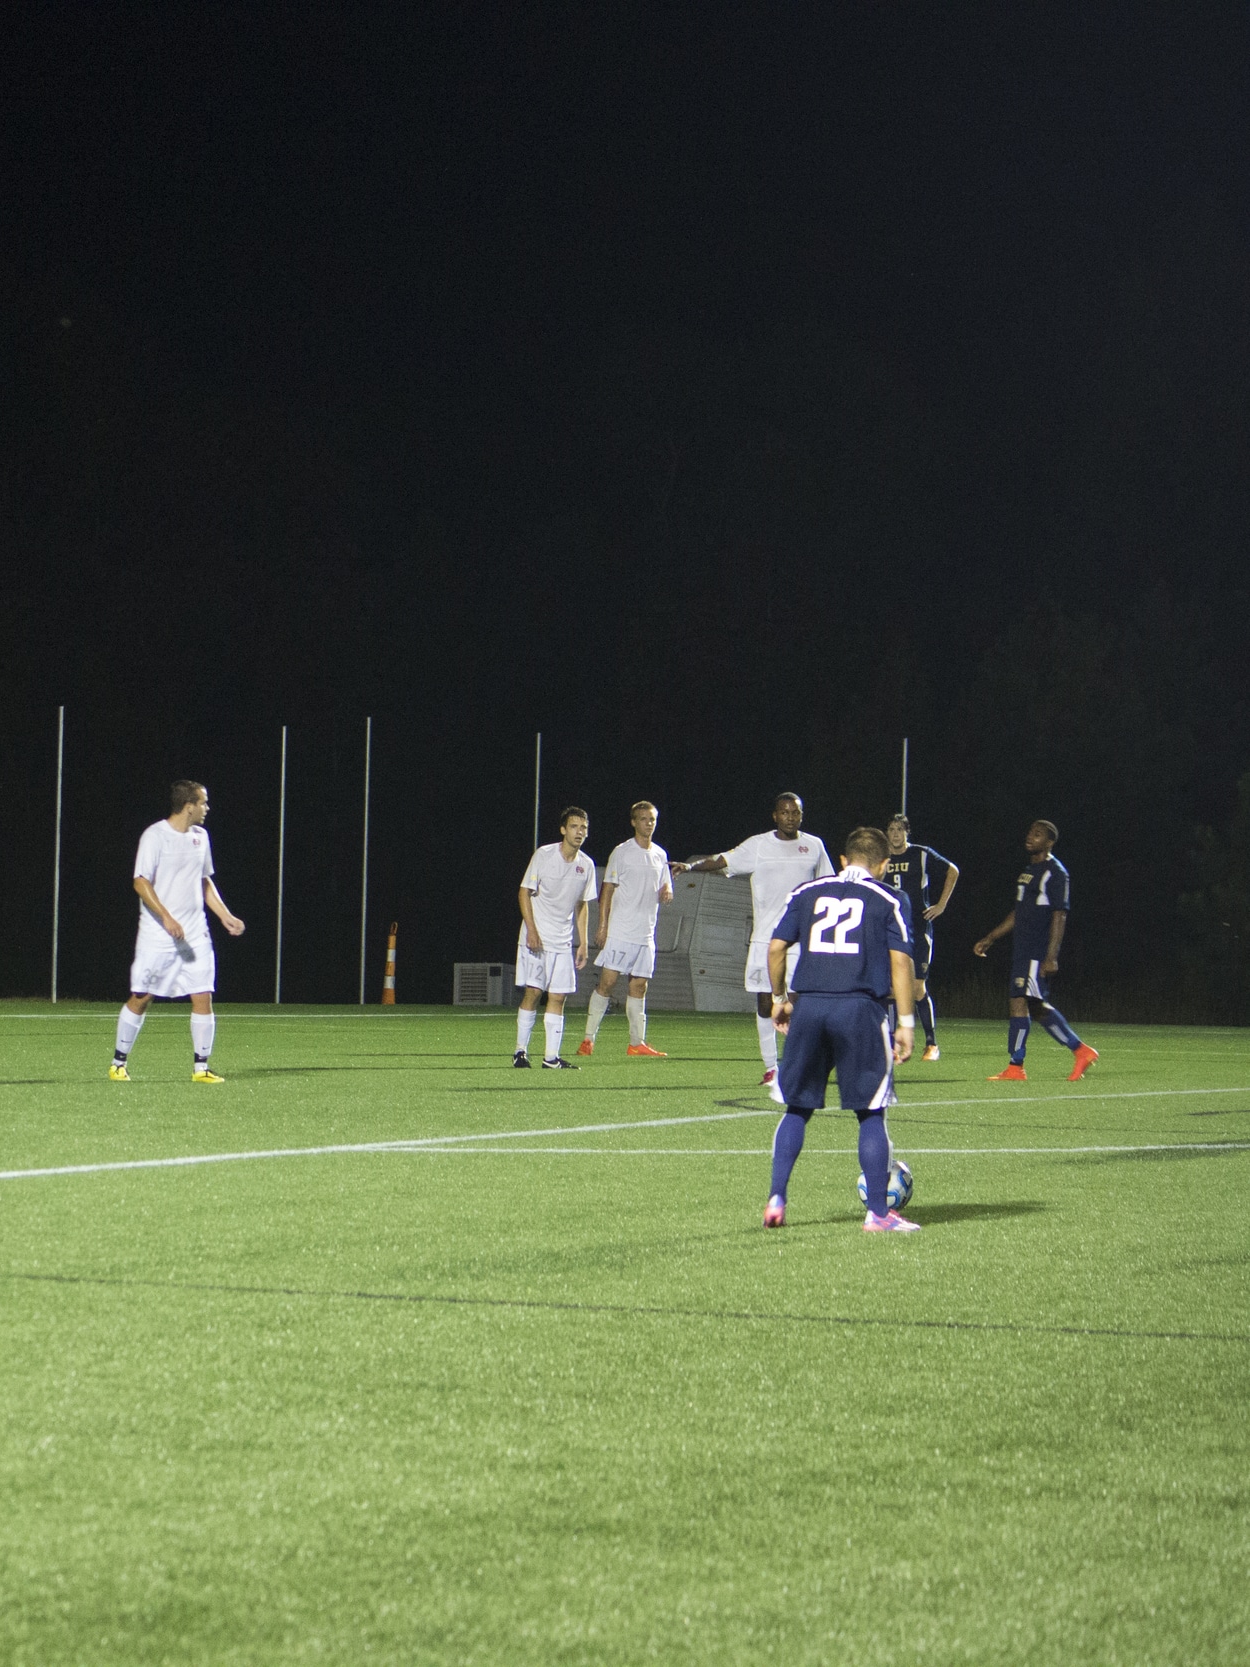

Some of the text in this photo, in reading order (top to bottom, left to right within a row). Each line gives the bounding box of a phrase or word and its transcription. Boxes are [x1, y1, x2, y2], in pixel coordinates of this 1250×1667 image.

[887, 862, 910, 875] CIU
[893, 874, 902, 890] 9
[808, 896, 865, 954] 22
[612, 949, 627, 966] 17
[529, 962, 544, 981] 12
